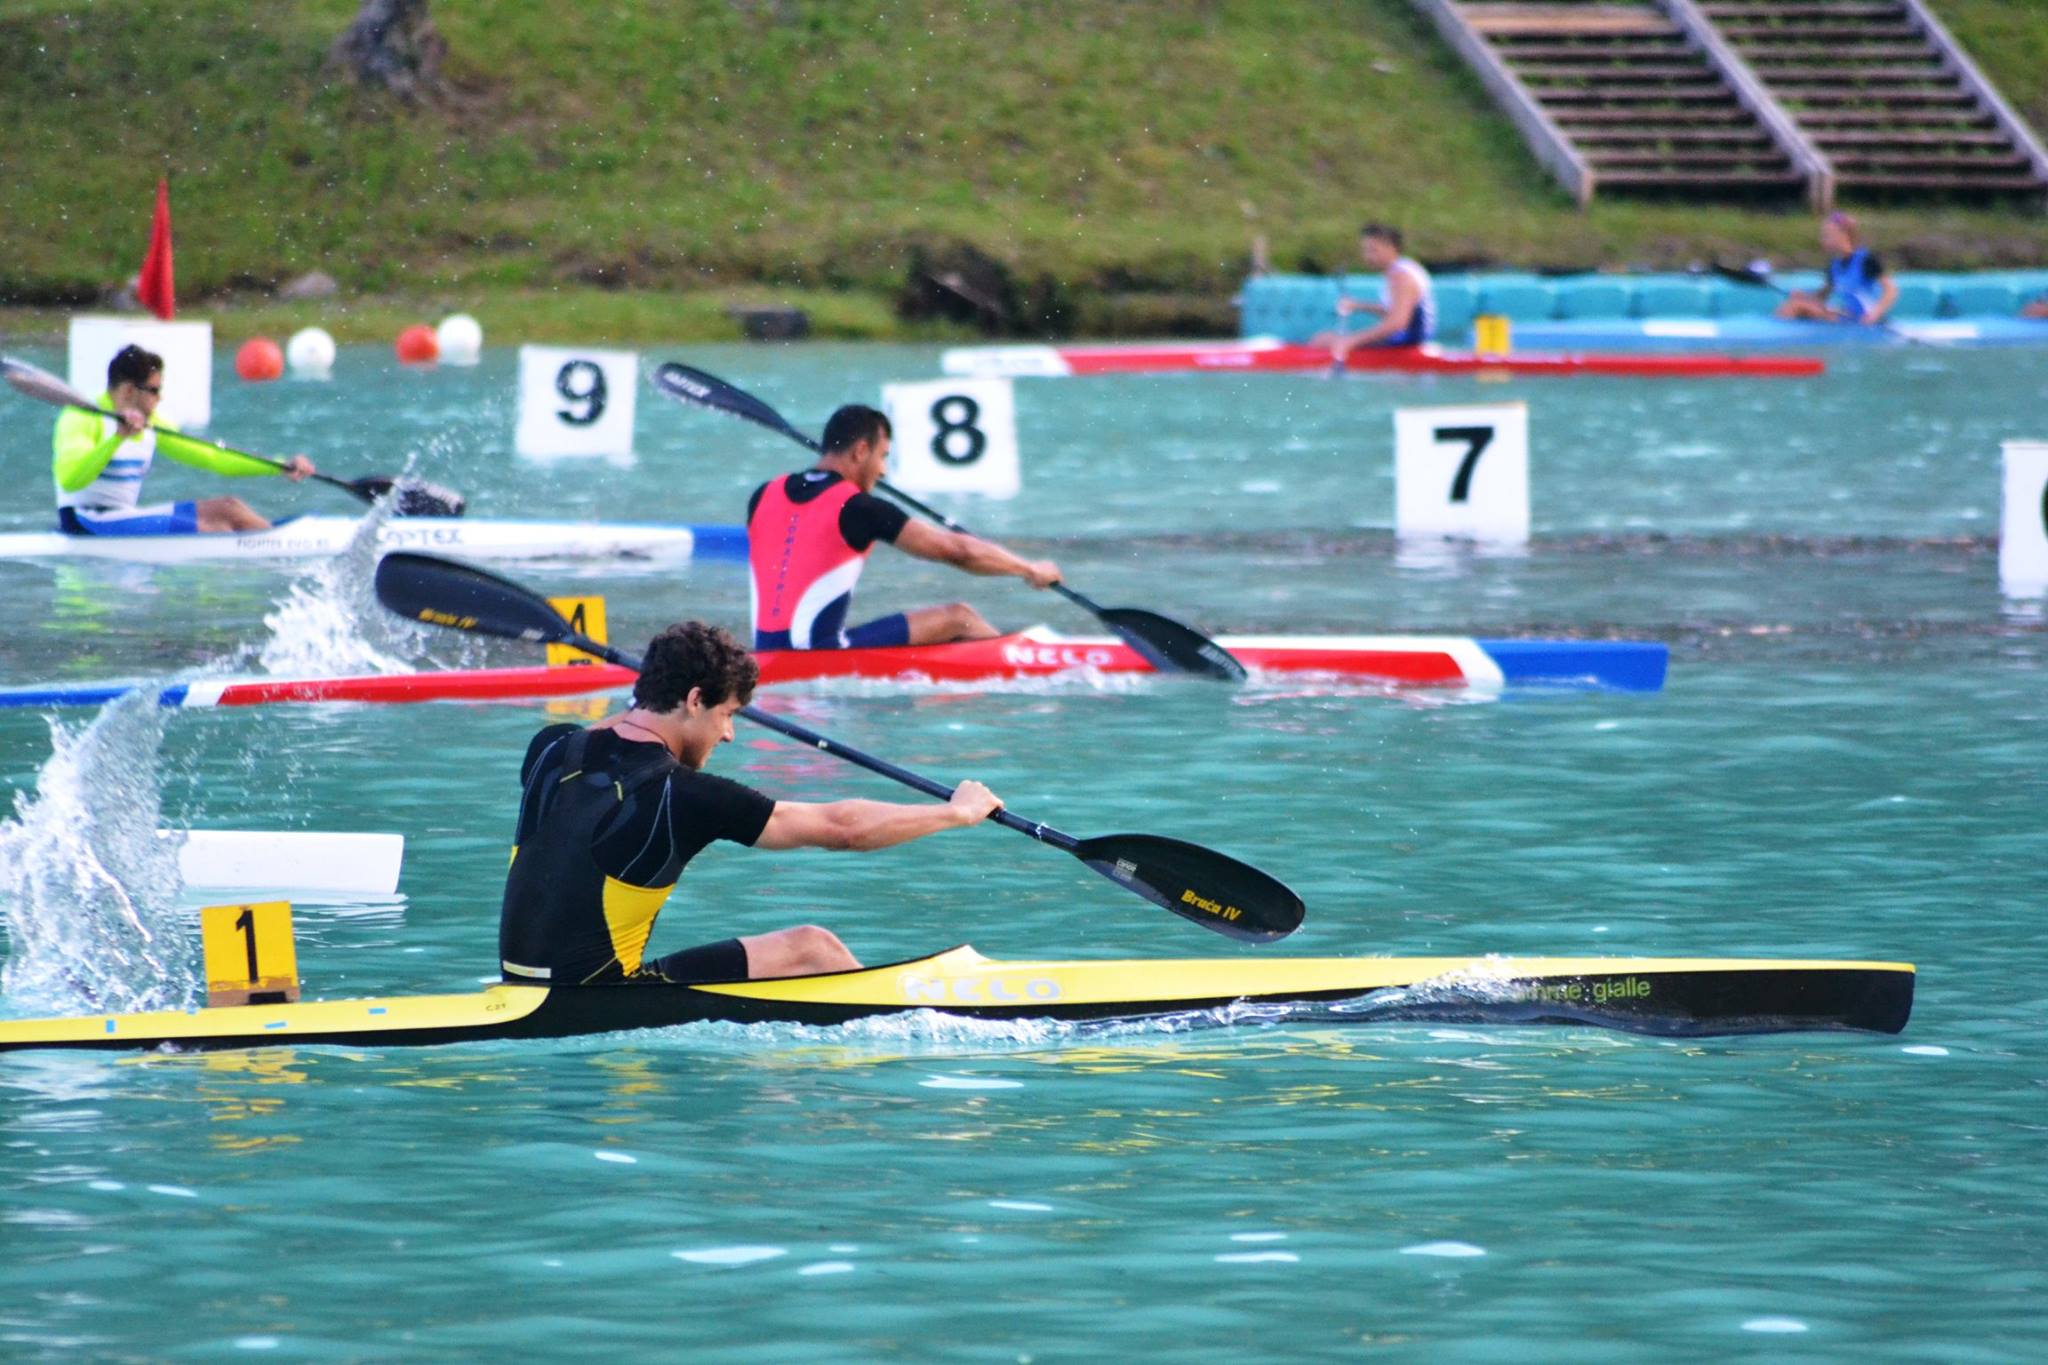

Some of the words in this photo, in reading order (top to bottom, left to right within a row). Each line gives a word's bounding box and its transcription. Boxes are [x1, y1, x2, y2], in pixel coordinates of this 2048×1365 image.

[556, 360, 608, 427] 9
[930, 395, 987, 467] 8
[1433, 426, 1494, 503] 7
[1003, 647, 1112, 666] NELO
[235, 908, 260, 984] 1
[1221, 906, 1242, 920] IV
[1592, 976, 1652, 1003] gialle
